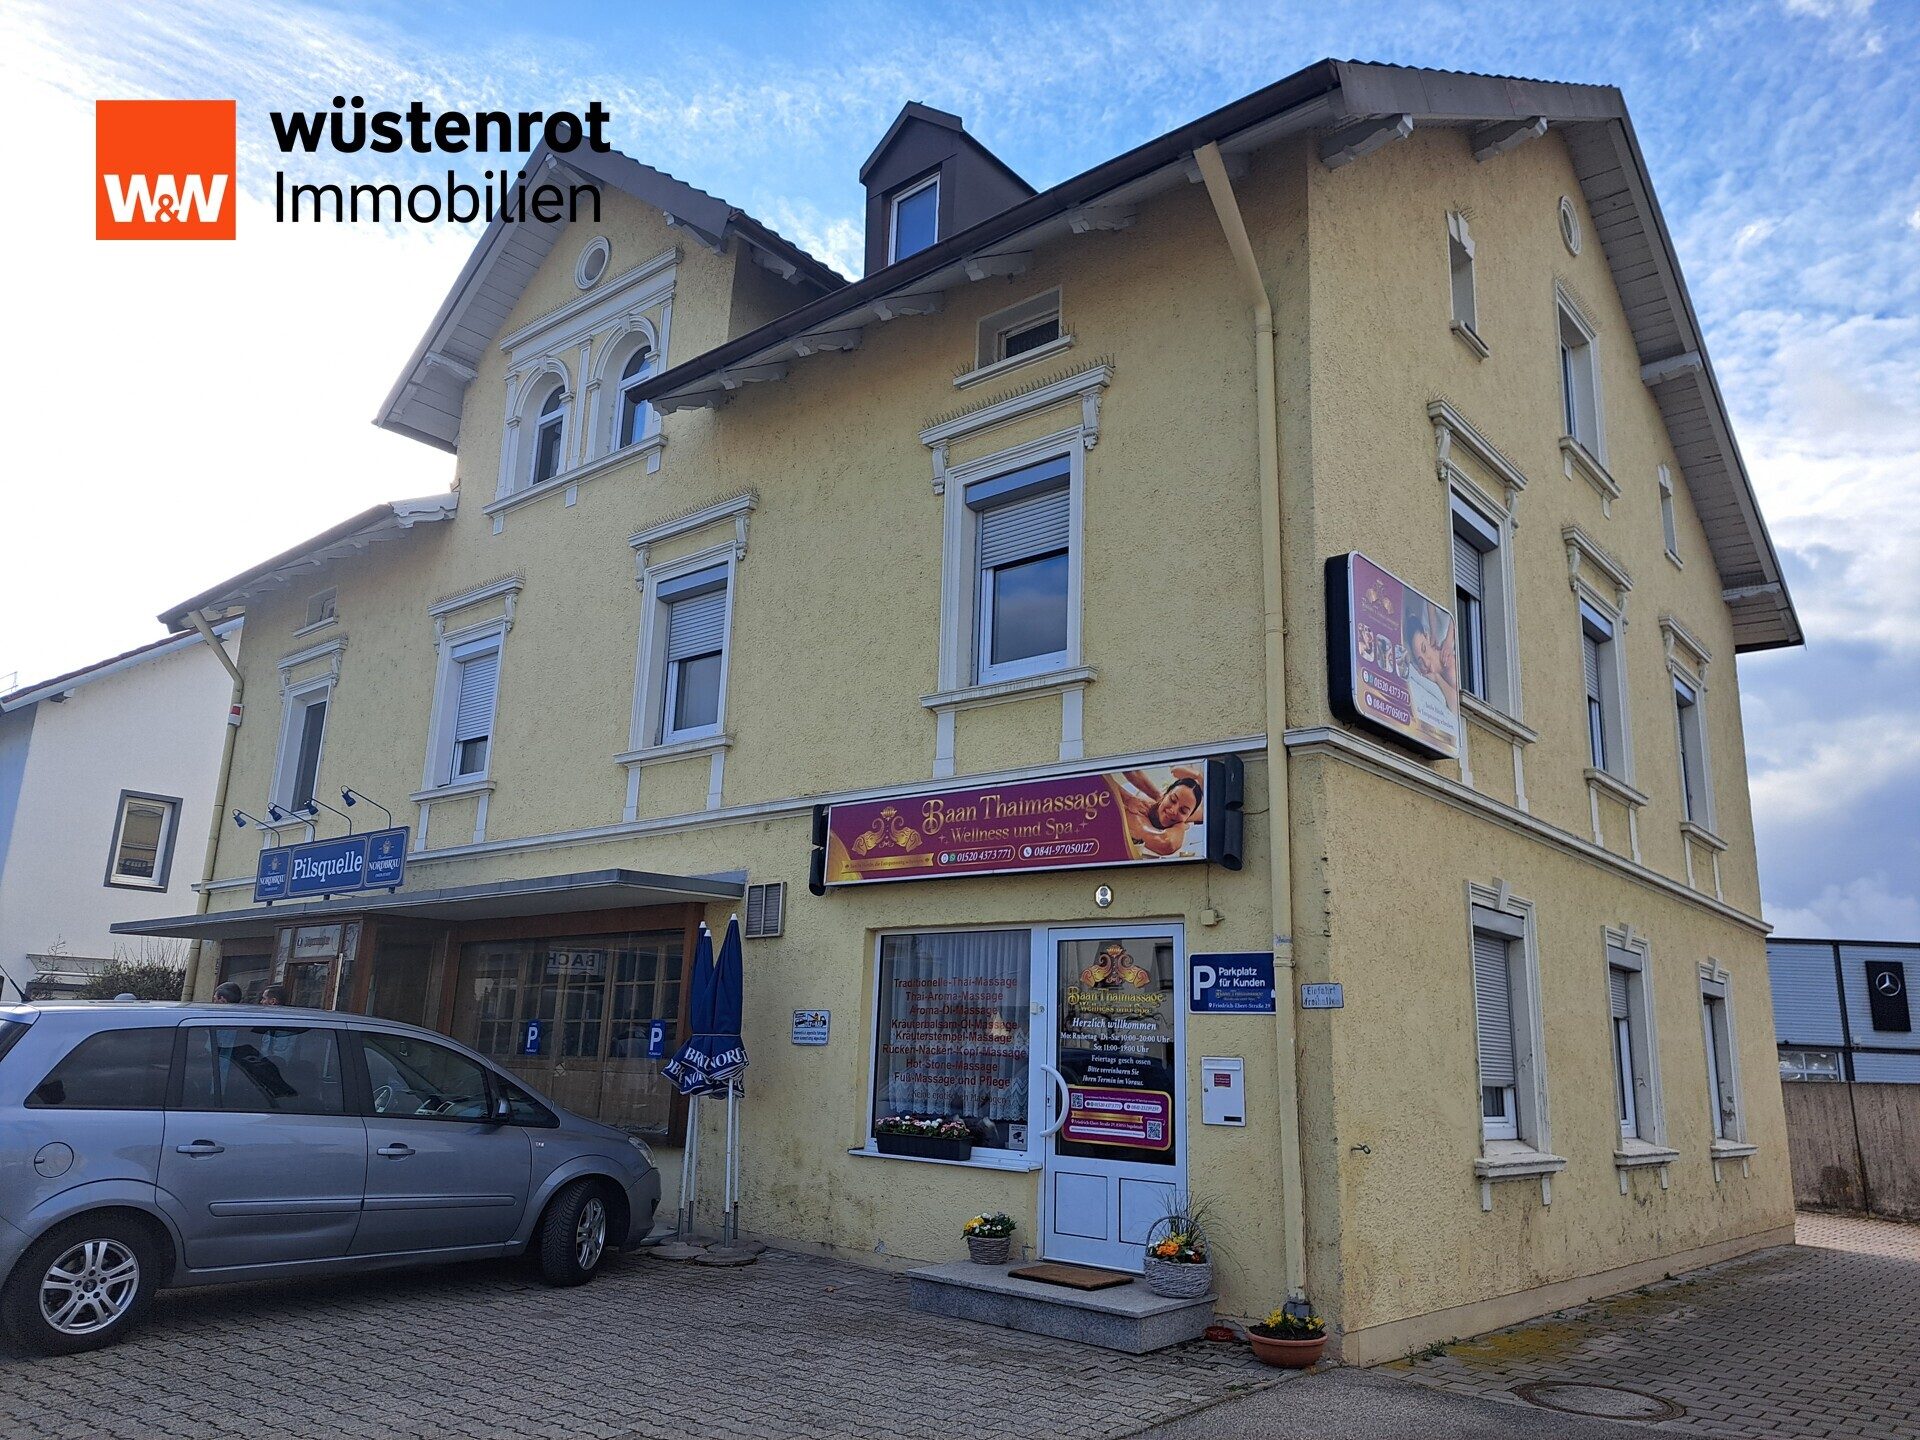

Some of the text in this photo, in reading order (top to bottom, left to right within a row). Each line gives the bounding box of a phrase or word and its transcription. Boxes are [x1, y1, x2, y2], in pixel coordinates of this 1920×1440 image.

[922, 790, 1110, 835] Baan Thaimassage
[951, 818, 1073, 843] Wellness und Spa
[957, 853, 978, 863] 01520
[1034, 843, 1094, 856] 0841-97050127
[292, 851, 362, 882] Pilsquelle
[1218, 967, 1257, 978] Parkplatz
[894, 977, 1018, 989] Traditionelle-Thai-Massage
[1193, 965, 1216, 1000] P
[1219, 978, 1265, 987] für Kunden
[906, 991, 1004, 1003] Thai-Aroma-Massage
[1068, 986, 1163, 1007] Baan Thaimassage
[1072, 1018, 1156, 1030] Herzlich willkommen
[526, 1026, 538, 1048] P
[649, 1027, 662, 1050] P
[1072, 1033, 1097, 1041] Ruhetag
[1157, 1035, 1170, 1043] Uhr
[1137, 1045, 1149, 1053] Uhr
[906, 1059, 998, 1073] Hot-Stone-Massage
[1091, 1055, 1116, 1064] Feiertags
[1087, 1065, 1099, 1073] Bitte
[1131, 1068, 1139, 1076] Sie
[894, 1072, 1010, 1089] Fuß-Massage und Pflege
[1082, 1075, 1097, 1083] Ihren
[1097, 1076, 1116, 1084] Termin
